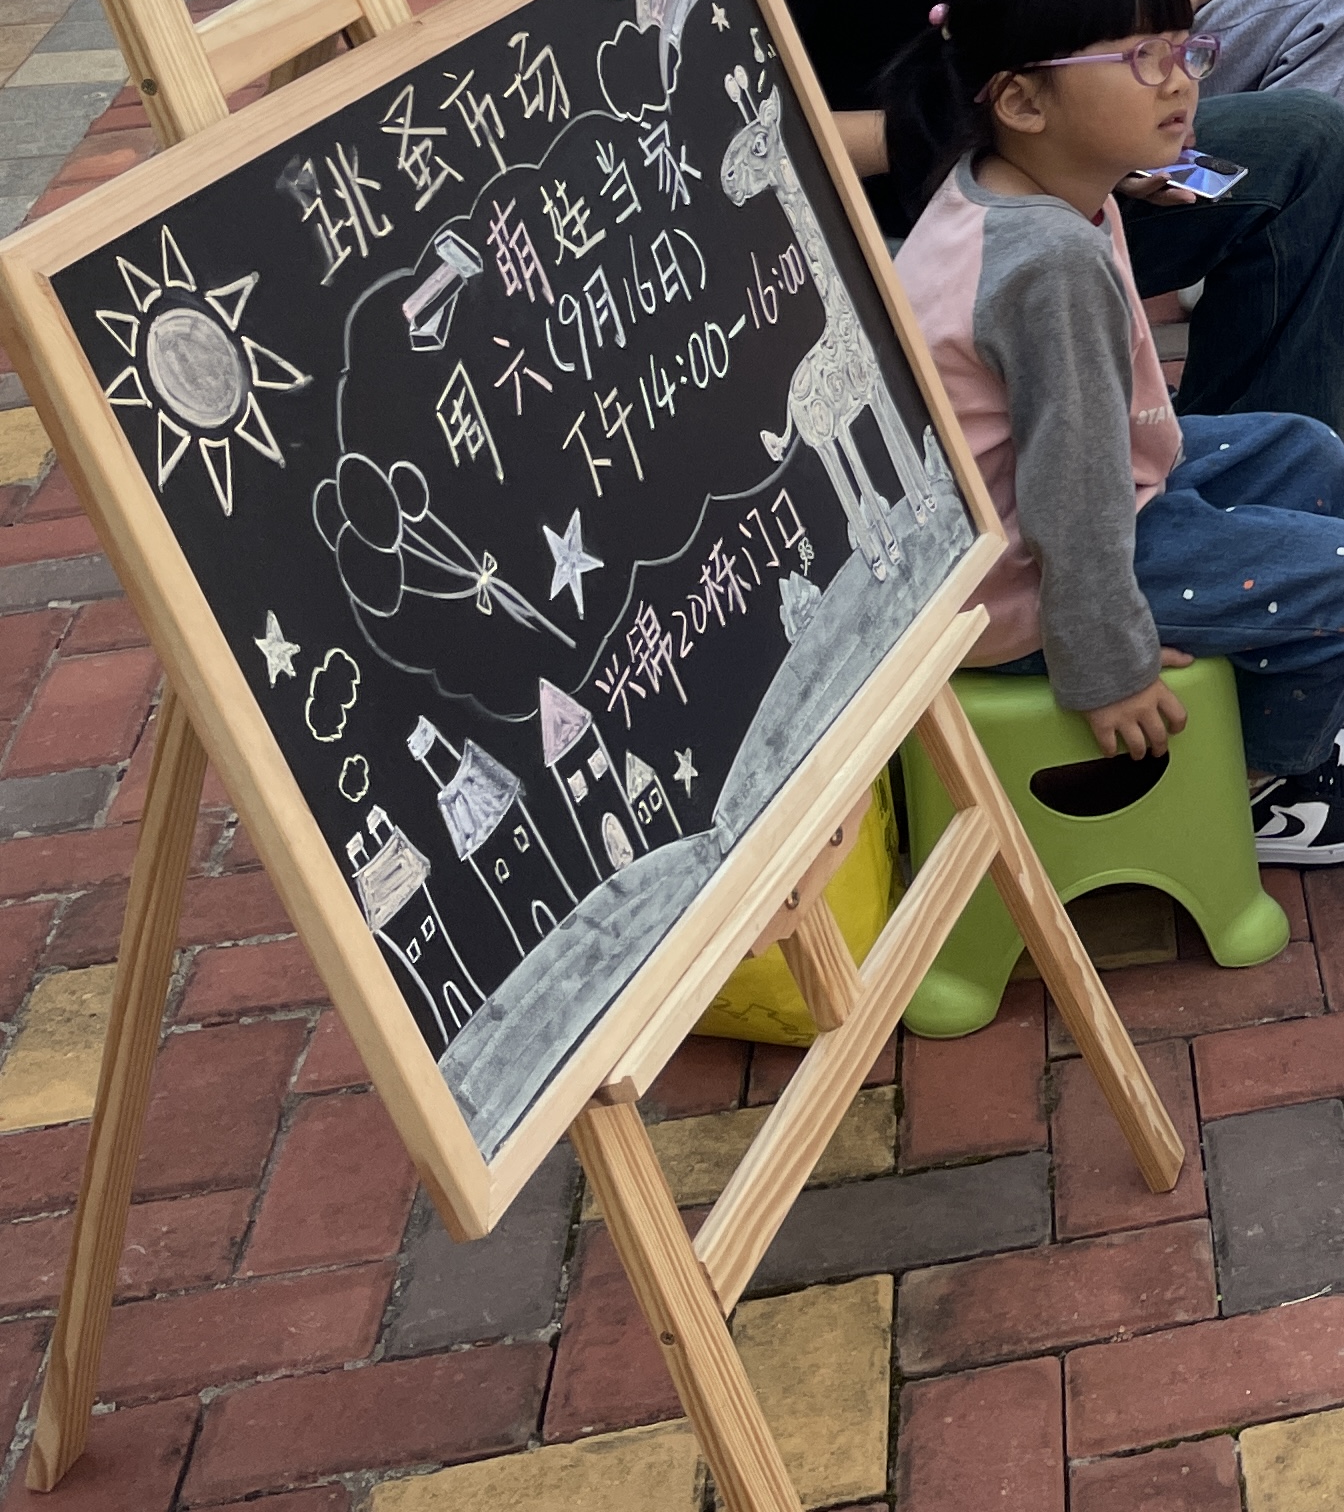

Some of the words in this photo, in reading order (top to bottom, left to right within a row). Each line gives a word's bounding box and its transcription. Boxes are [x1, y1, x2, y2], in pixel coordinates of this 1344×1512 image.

[302, 31, 571, 286] 跳蚤市场
[487, 120, 702, 306] 萌娃当家
